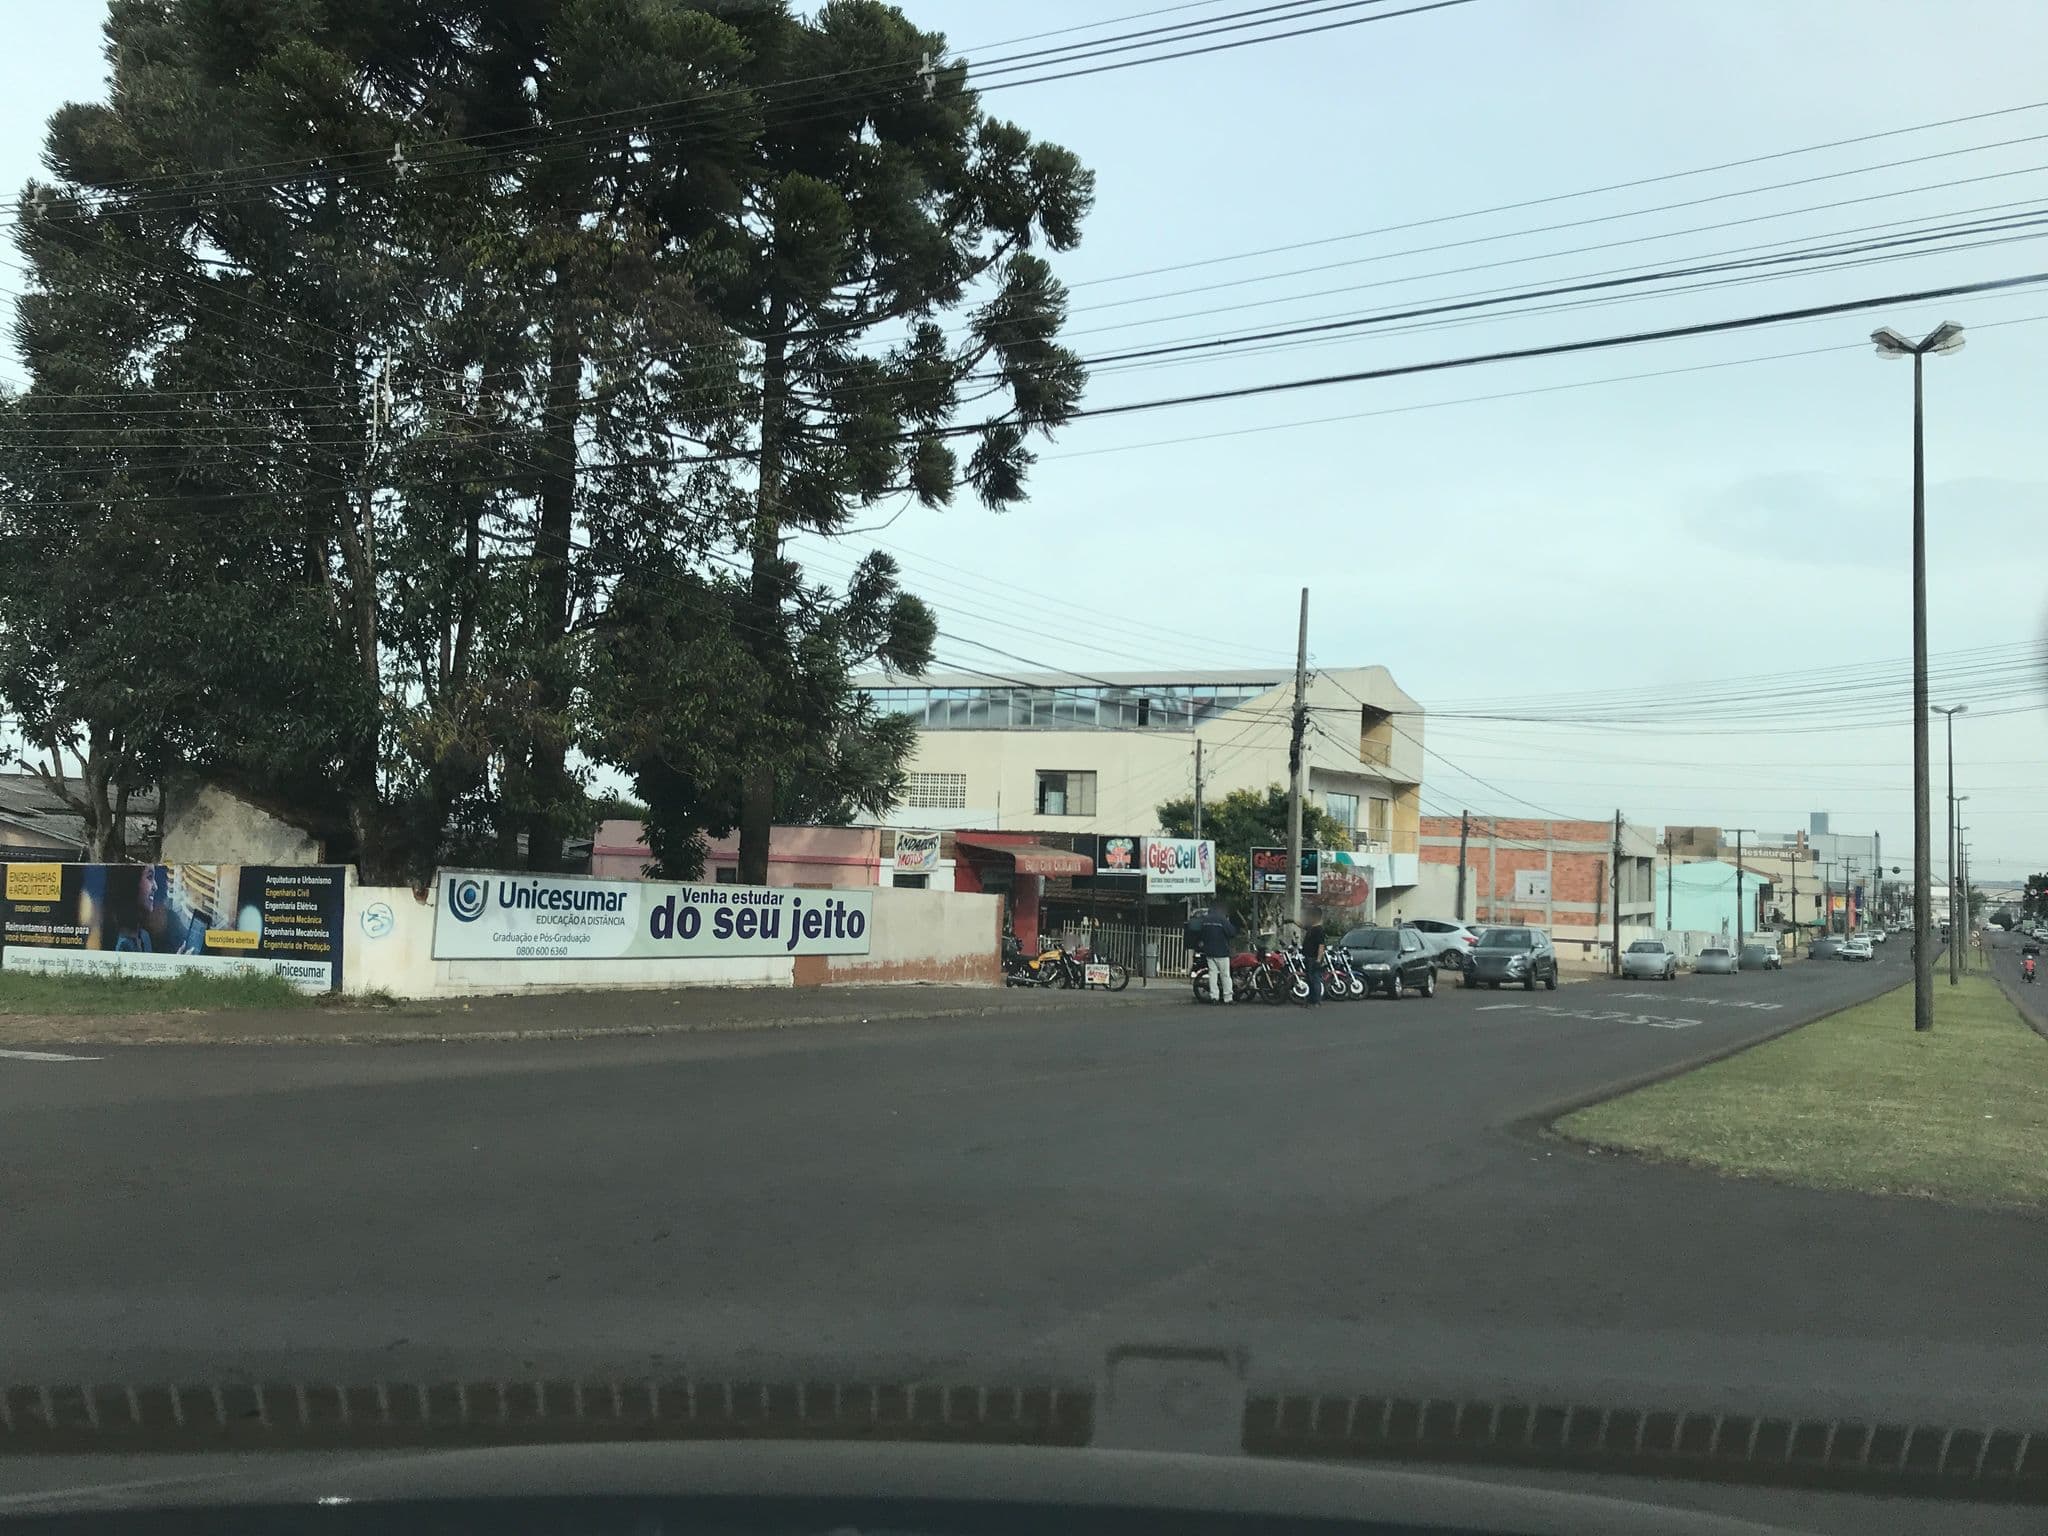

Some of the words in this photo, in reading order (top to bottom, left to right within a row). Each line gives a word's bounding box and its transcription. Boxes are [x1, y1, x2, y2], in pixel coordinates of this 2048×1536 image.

[8, 871, 57, 883] ENGENHARIAS
[266, 875, 296, 885] Arquitetura
[301, 876, 332, 885] Urbanismo
[14, 884, 60, 896] ARQUITETURA
[265, 888, 296, 898] Engenharia
[297, 888, 310, 897] Civil
[498, 879, 628, 912] Unicesumar
[681, 887, 729, 905] Venha
[731, 889, 786, 906] estudar
[265, 901, 296, 911] Engenharia
[296, 901, 318, 911] Elétrica
[264, 914, 295, 925] Engenharia
[296, 915, 322, 924] Mecânica
[536, 913, 578, 928] EDUCAÇÃO
[586, 913, 626, 927] DISTÂNCIA
[649, 894, 702, 940] do
[712, 903, 780, 940] seu
[786, 897, 867, 951] jeito
[5, 921, 47, 933] Reinventamos
[47, 925, 53, 933] o
[53, 923, 75, 934] ensino
[75, 926, 90, 937] para
[264, 927, 295, 937] Engenharia
[295, 928, 330, 938] Mecatrônica
[208, 935, 235, 944] Inscrições
[236, 936, 255, 945] abertas
[492, 931, 533, 945] Graduação
[533, 935, 539, 943] e
[539, 931, 592, 945] Pós-Graduação
[263, 940, 294, 950] Engenharia
[295, 942, 302, 950] de
[303, 942, 331, 952] Produção
[516, 946, 535, 957] 0800
[535, 946, 549, 957] 600
[550, 946, 568, 956] 6360
[275, 962, 325, 978] Unicesumar
